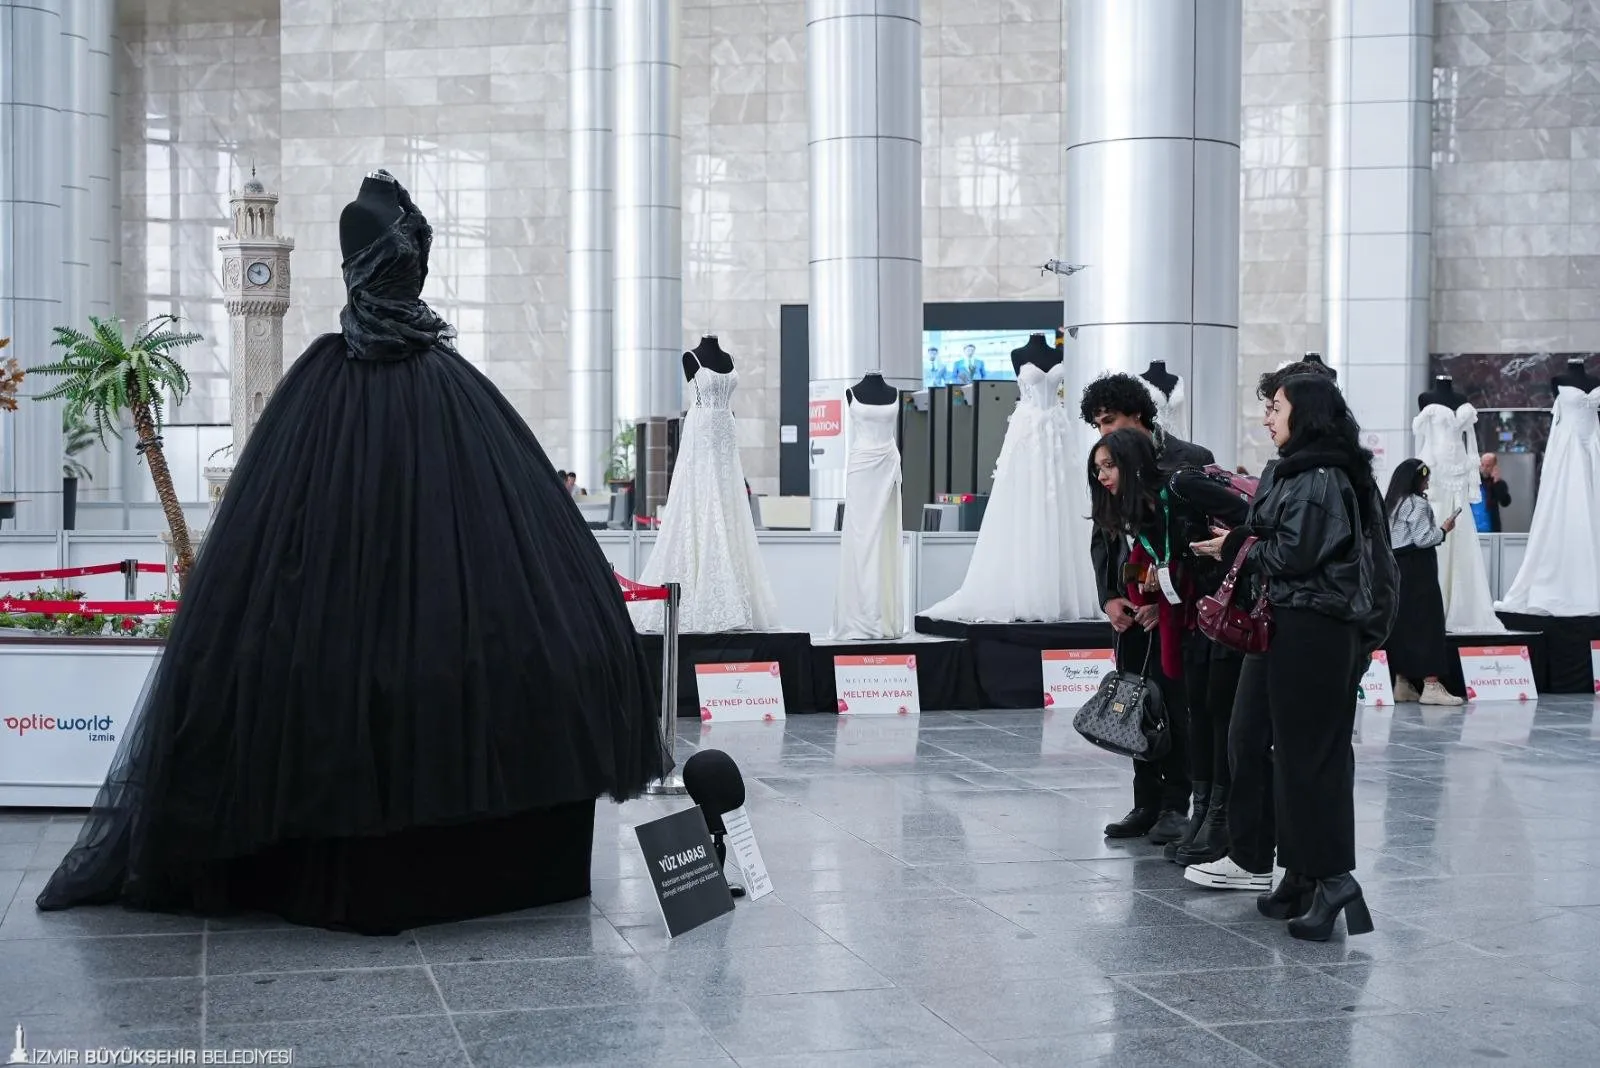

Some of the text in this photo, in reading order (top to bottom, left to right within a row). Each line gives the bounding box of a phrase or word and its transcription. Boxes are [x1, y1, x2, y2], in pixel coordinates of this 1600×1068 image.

[809, 405, 827, 418] AYIT
[1503, 677, 1530, 686] GELEN
[1361, 682, 1383, 691] LDIZ
[843, 689, 913, 698] MELTEM AYBAR
[706, 697, 779, 707] ZEYNEP OLGUN
[658, 845, 707, 873] YÜZ KARASI
